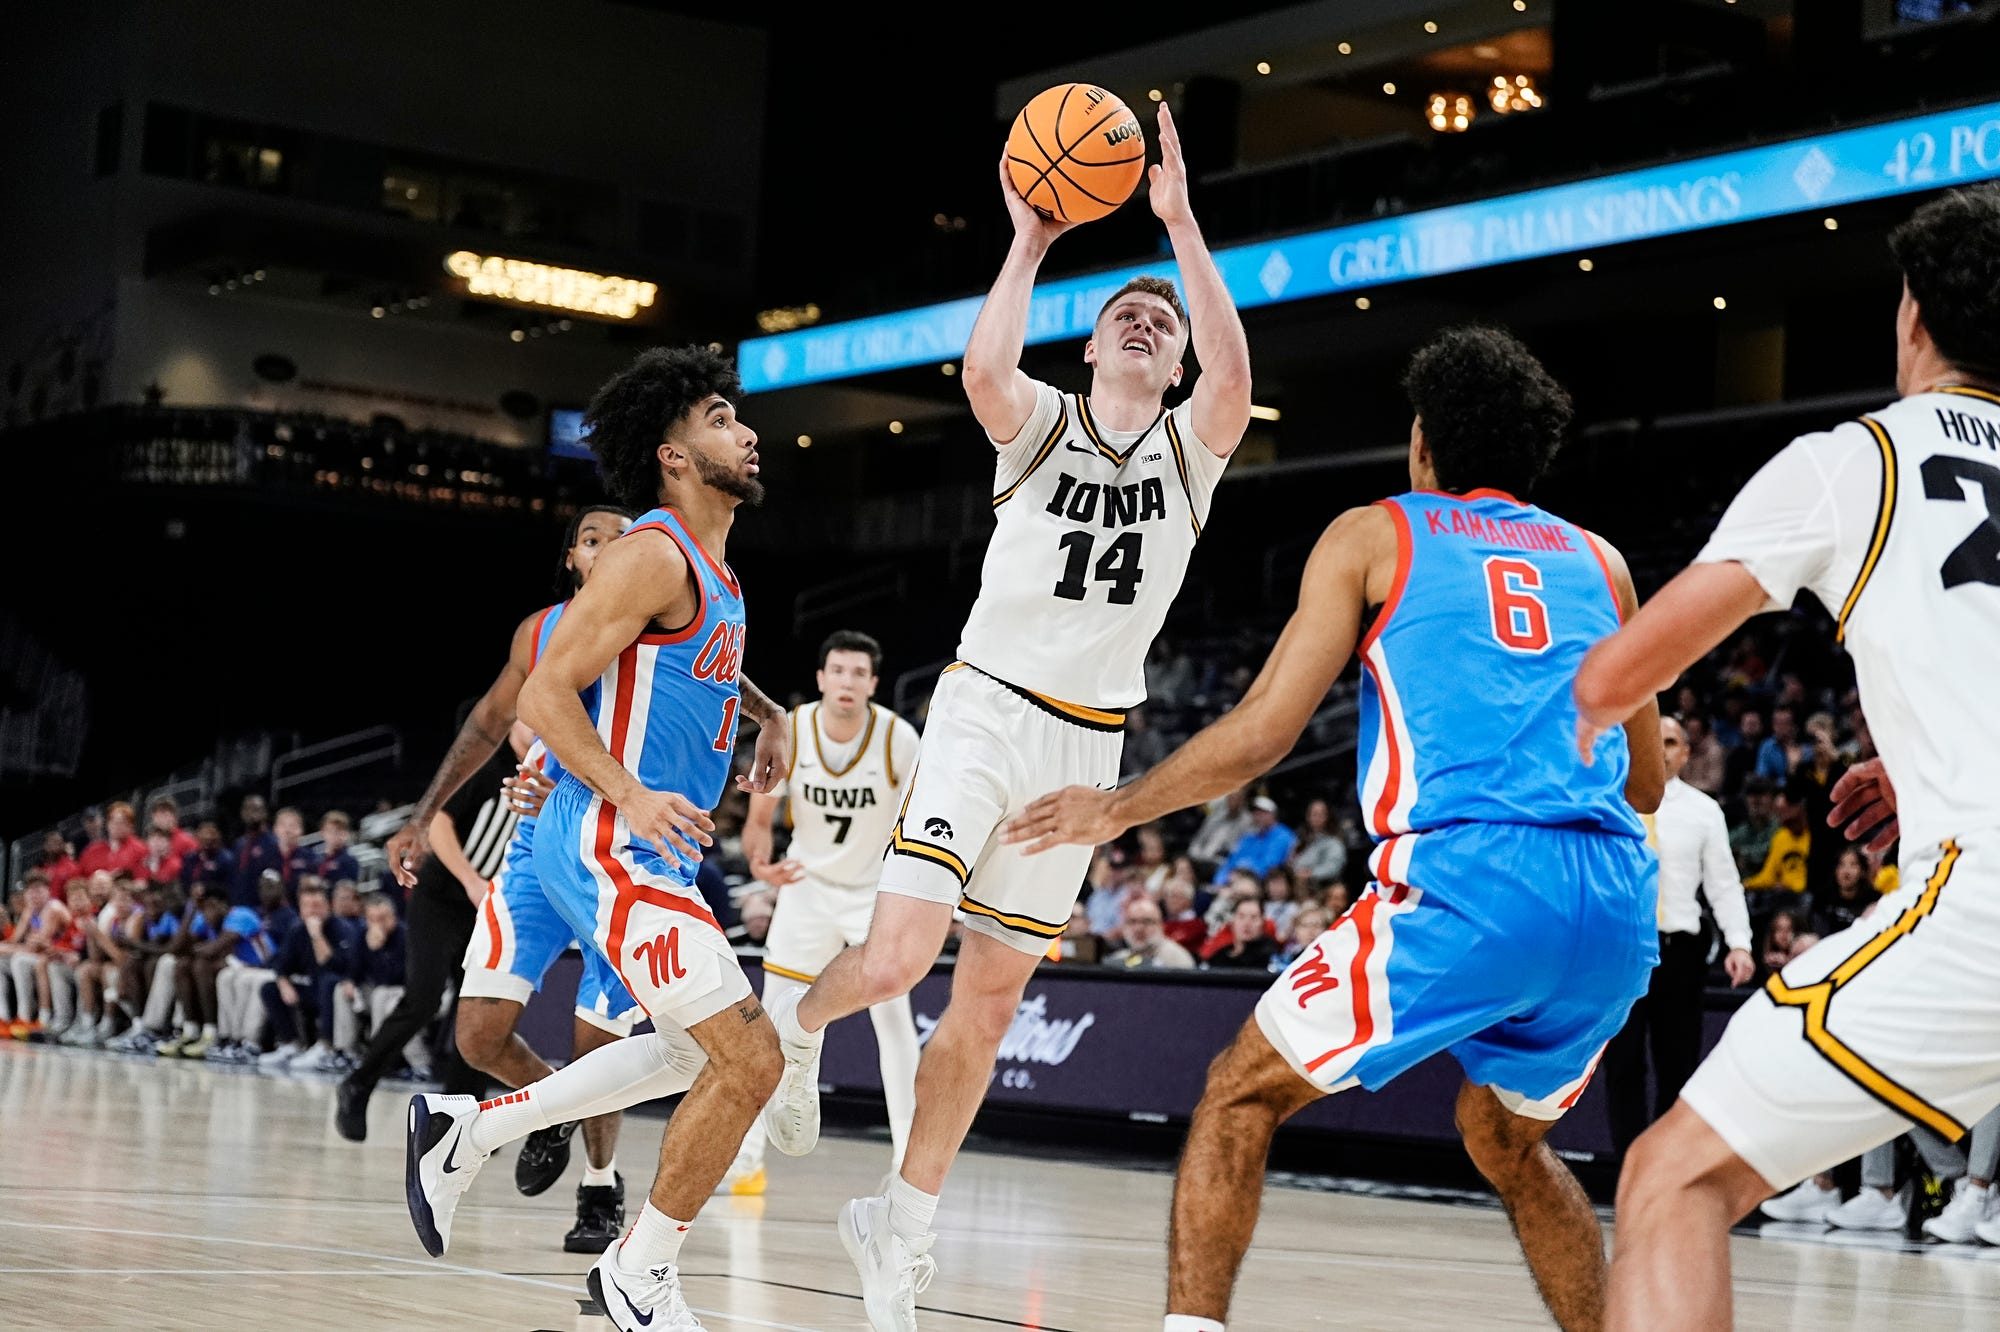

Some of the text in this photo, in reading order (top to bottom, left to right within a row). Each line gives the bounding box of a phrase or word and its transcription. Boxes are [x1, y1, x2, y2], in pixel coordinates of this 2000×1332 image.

[1883, 131, 1937, 184] 42
[1328, 169, 1744, 286] GREATER PALM SPRINGS
[1045, 472, 1166, 529] IOWA
[1424, 508, 1577, 553] KAMARDINE
[1053, 530, 1144, 605] 14
[1482, 555, 1553, 655] 6
[713, 696, 738, 752] 1
[803, 783, 876, 809] IOWA
[824, 814, 852, 844] 7
[632, 926, 687, 989] M
